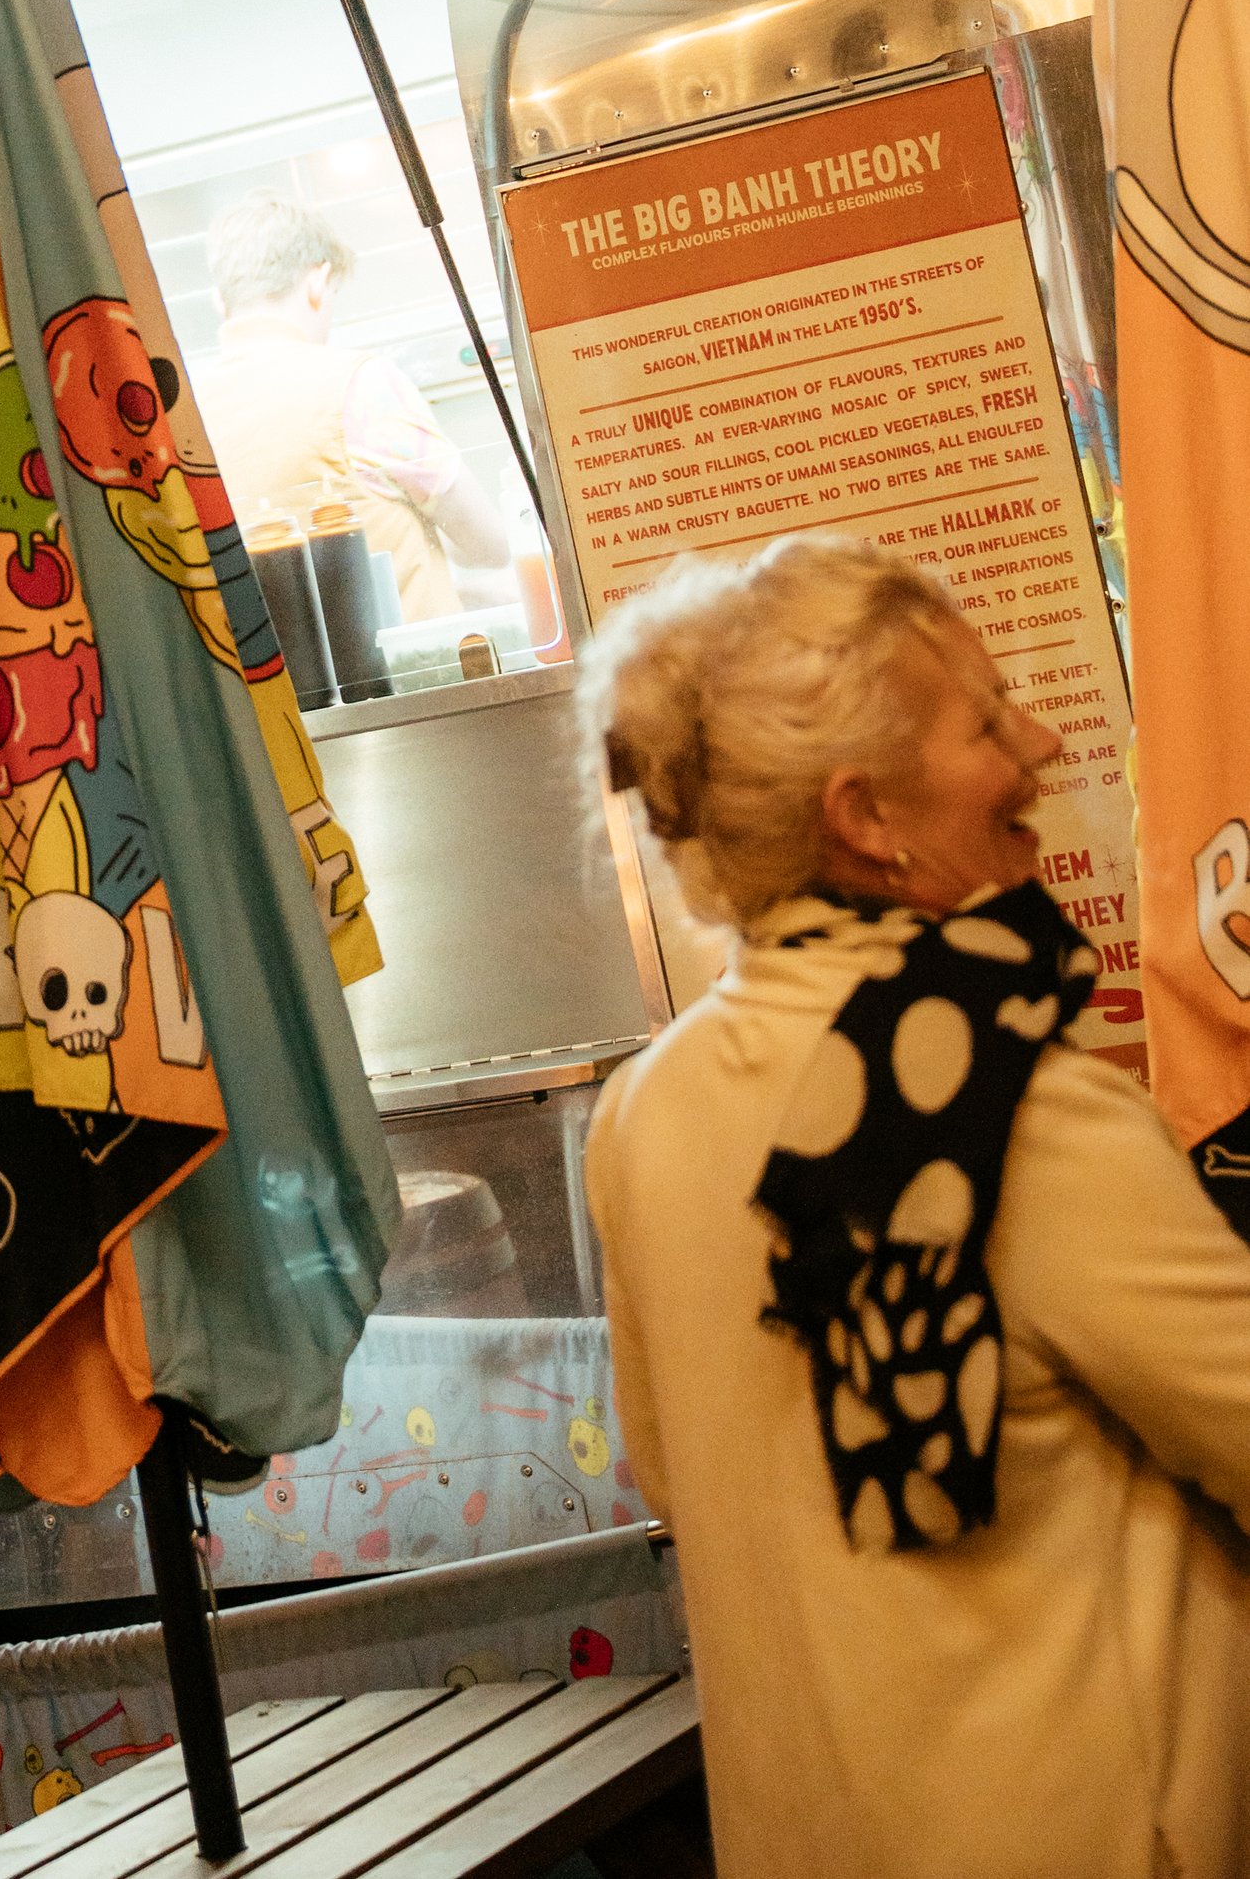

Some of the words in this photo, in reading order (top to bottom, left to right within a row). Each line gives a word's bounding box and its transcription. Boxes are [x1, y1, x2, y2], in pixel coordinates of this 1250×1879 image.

[561, 209, 627, 257] THE
[633, 194, 690, 240] BIG
[698, 167, 798, 224] BANH
[804, 131, 940, 197] THEORY
[591, 243, 658, 270] COMPLEX
[659, 226, 731, 254] FLAVOURS
[732, 216, 775, 237] FROM
[775, 202, 834, 227] HUMBLE
[836, 180, 924, 212] BEGINNINGS
[572, 344, 602, 359] THIS
[605, 325, 690, 352] WONDERFUL
[693, 307, 762, 332] CREATION
[765, 287, 849, 316] ORIGINATED
[852, 283, 867, 296] IN
[868, 276, 897, 292] THE
[900, 261, 962, 285] STREETS
[965, 255, 984, 270] OF
[643, 352, 699, 374] SAIGON,
[700, 329, 773, 360] VIETNAM
[776, 331, 791, 344] IN
[793, 324, 821, 339] THE
[823, 315, 858, 333] LATE
[571, 434, 581, 447] A
[585, 424, 625, 442] TRULY
[632, 403, 692, 432] UNIQUE
[699, 386, 797, 417] COMBINATION
[803, 380, 821, 394] OF
[829, 363, 906, 389] FLAVOURS,
[911, 344, 987, 370] TEXTURES
[995, 336, 1025, 353] AND
[574, 436, 685, 471] TEMPERATURES.
[695, 431, 713, 445] AN
[722, 407, 821, 438] EVER-VARYING
[831, 393, 887, 415] MOSAIC
[897, 386, 915, 400] OF
[926, 375, 970, 394] SPICY,
[979, 362, 1031, 383] SWEET,
[582, 481, 619, 498] SALTY
[629, 473, 656, 489] AND
[662, 464, 700, 481] SOUR
[705, 450, 769, 472] FILLINGS,
[774, 440, 814, 457] COOL
[819, 425, 878, 448] PICKLED
[883, 404, 977, 434] VEGETABLES,
[981, 385, 1037, 412] FRESH
[587, 505, 630, 523] HERBS
[635, 498, 662, 513] AND
[666, 486, 717, 506] SUBTLE
[720, 477, 761, 495] HINTS
[765, 472, 783, 486] OF
[787, 461, 836, 481] UMAMI
[839, 441, 934, 470] SEASONINGS,
[938, 434, 964, 449] ALL
[967, 417, 1042, 443] ENGULFED
[592, 536, 605, 548] IN
[613, 533, 621, 544] A
[627, 522, 670, 540] WARM
[676, 510, 728, 530] CRUSTY
[736, 493, 813, 518] BAGUETTE.
[818, 487, 840, 501] NO
[846, 478, 880, 494] TWO
[887, 468, 927, 487] BITES
[935, 460, 962, 477] ARE
[968, 453, 998, 469] THE
[1004, 443, 1049, 462] SAME.
[876, 530, 905, 546] ARE
[909, 523, 938, 539] THE
[940, 497, 1036, 533] HALLMARK
[1040, 498, 1062, 513] OF
[943, 542, 976, 560] OUR
[978, 524, 1068, 553] INFLUENCES
[970, 550, 1073, 581] INSPIRATIONS
[995, 589, 1016, 603] TO
[1022, 576, 1079, 598] CREATE
[985, 620, 1015, 636] THE
[1017, 606, 1086, 630] COSMOS.
[1028, 670, 1057, 686] THE
[1059, 662, 1098, 680] VIET-
[1058, 715, 1110, 737] WARM,
[1085, 744, 1117, 761] ARE
[1039, 777, 1089, 796] BLEND
[1101, 771, 1123, 785] OF
